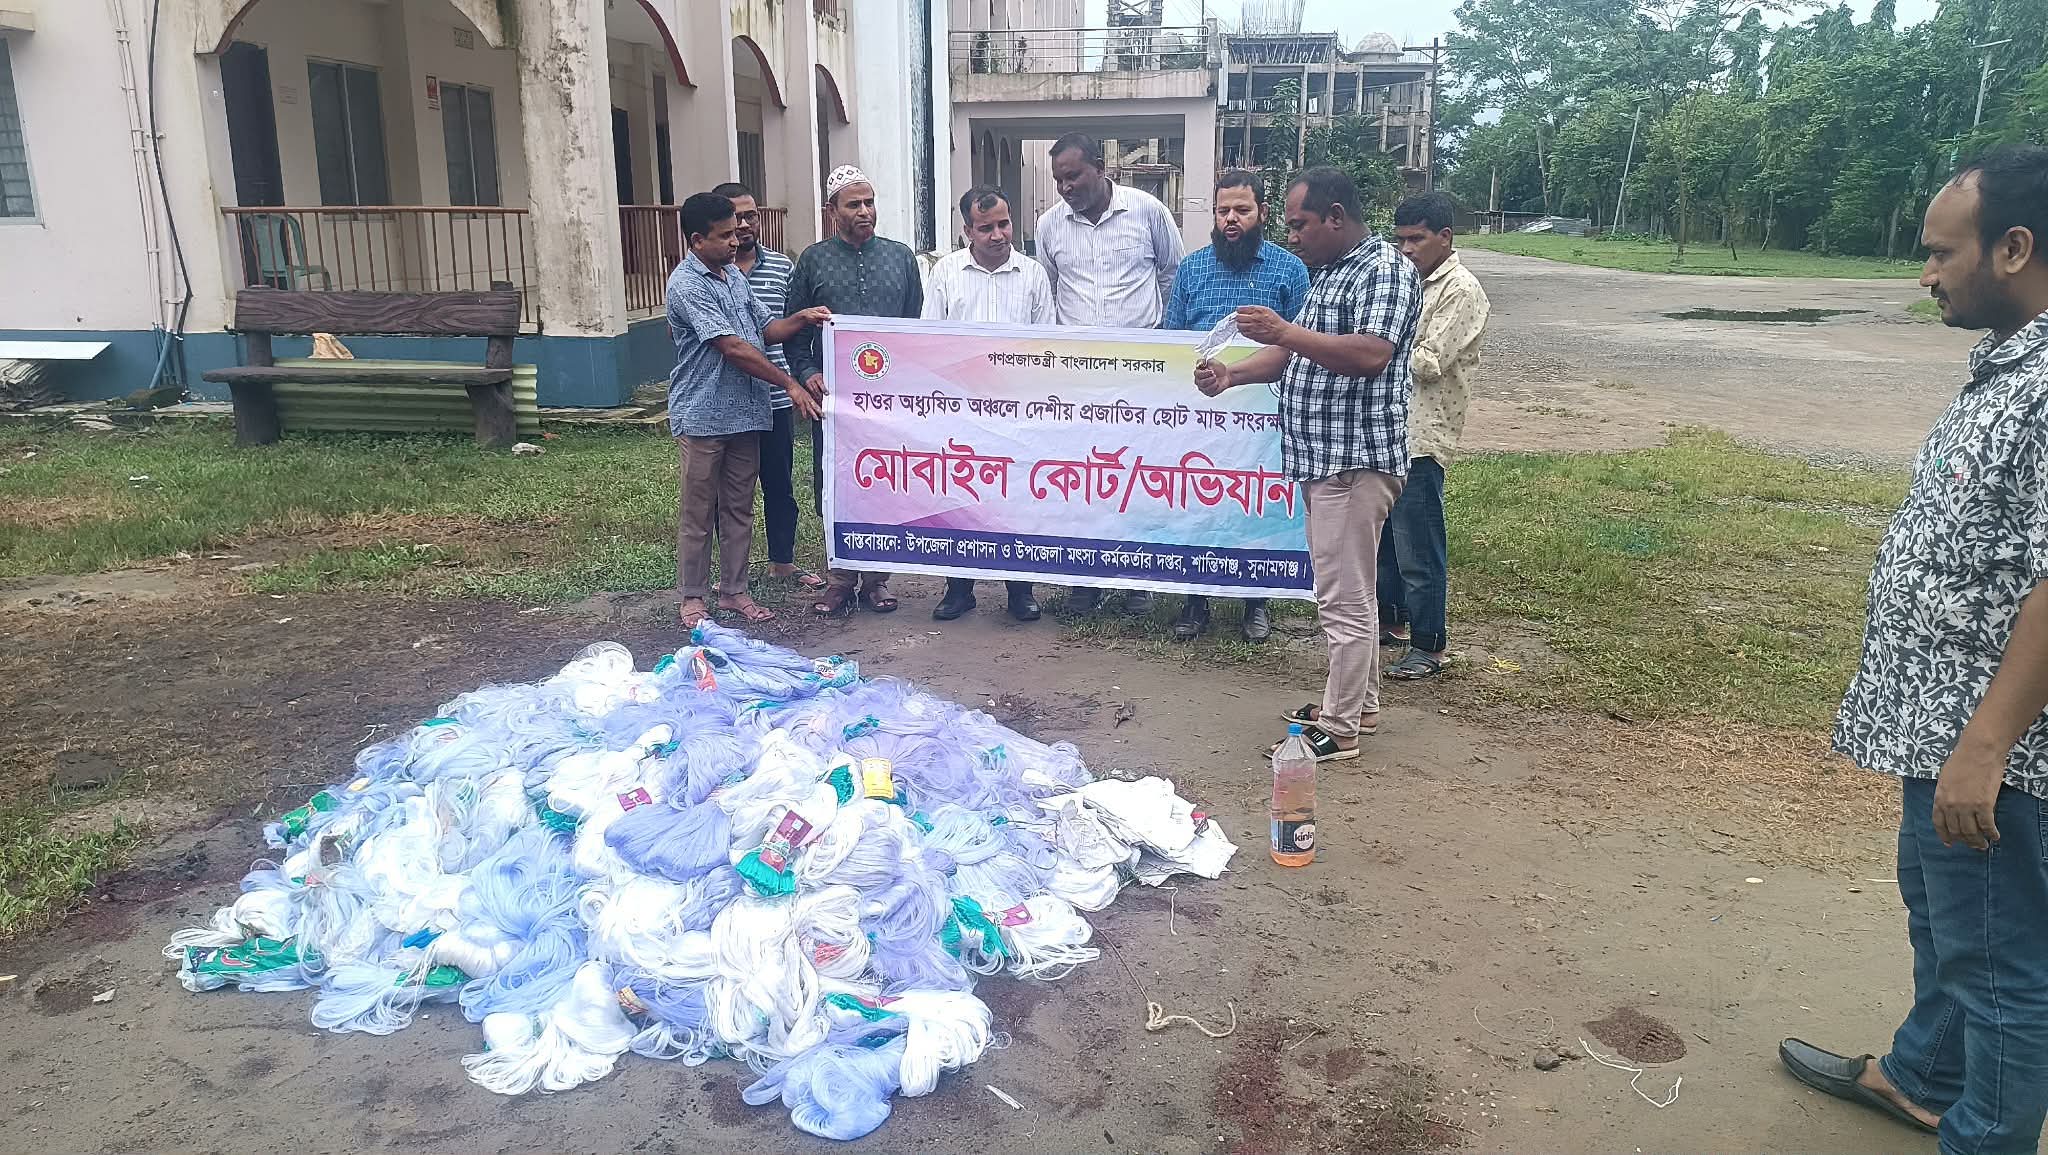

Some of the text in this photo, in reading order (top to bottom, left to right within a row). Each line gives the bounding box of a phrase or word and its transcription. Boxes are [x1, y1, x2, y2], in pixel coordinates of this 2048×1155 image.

[987, 350, 1165, 374] গণপ্রজাতন্ত্রী বাংলাদেশ সরকার
[852, 390, 894, 412] হাওর
[898, 389, 962, 418] অধ্যুষিত
[966, 398, 1019, 418] অঞ্চলে
[1025, 395, 1075, 422] দেশীয়
[1079, 399, 1147, 425] প্রজাতির
[1152, 402, 1190, 428] ছোট
[1194, 408, 1228, 433] মাছ
[854, 437, 1296, 520] মোবাইল কোর্ট/অভিযান
[905, 530, 954, 556] উপজেলা
[956, 539, 998, 560] প্রশাসন
[1001, 546, 1011, 559] ও
[1014, 541, 1064, 565] উপজেলা
[1067, 547, 1098, 568] মৎস্য
[1100, 545, 1154, 570] কর্মকর্তার
[1156, 554, 1188, 576] দপ্তর,
[1191, 551, 1243, 579] শান্তিগঞ্জ,
[1247, 559, 1299, 580] সুনামগঞ্জ
